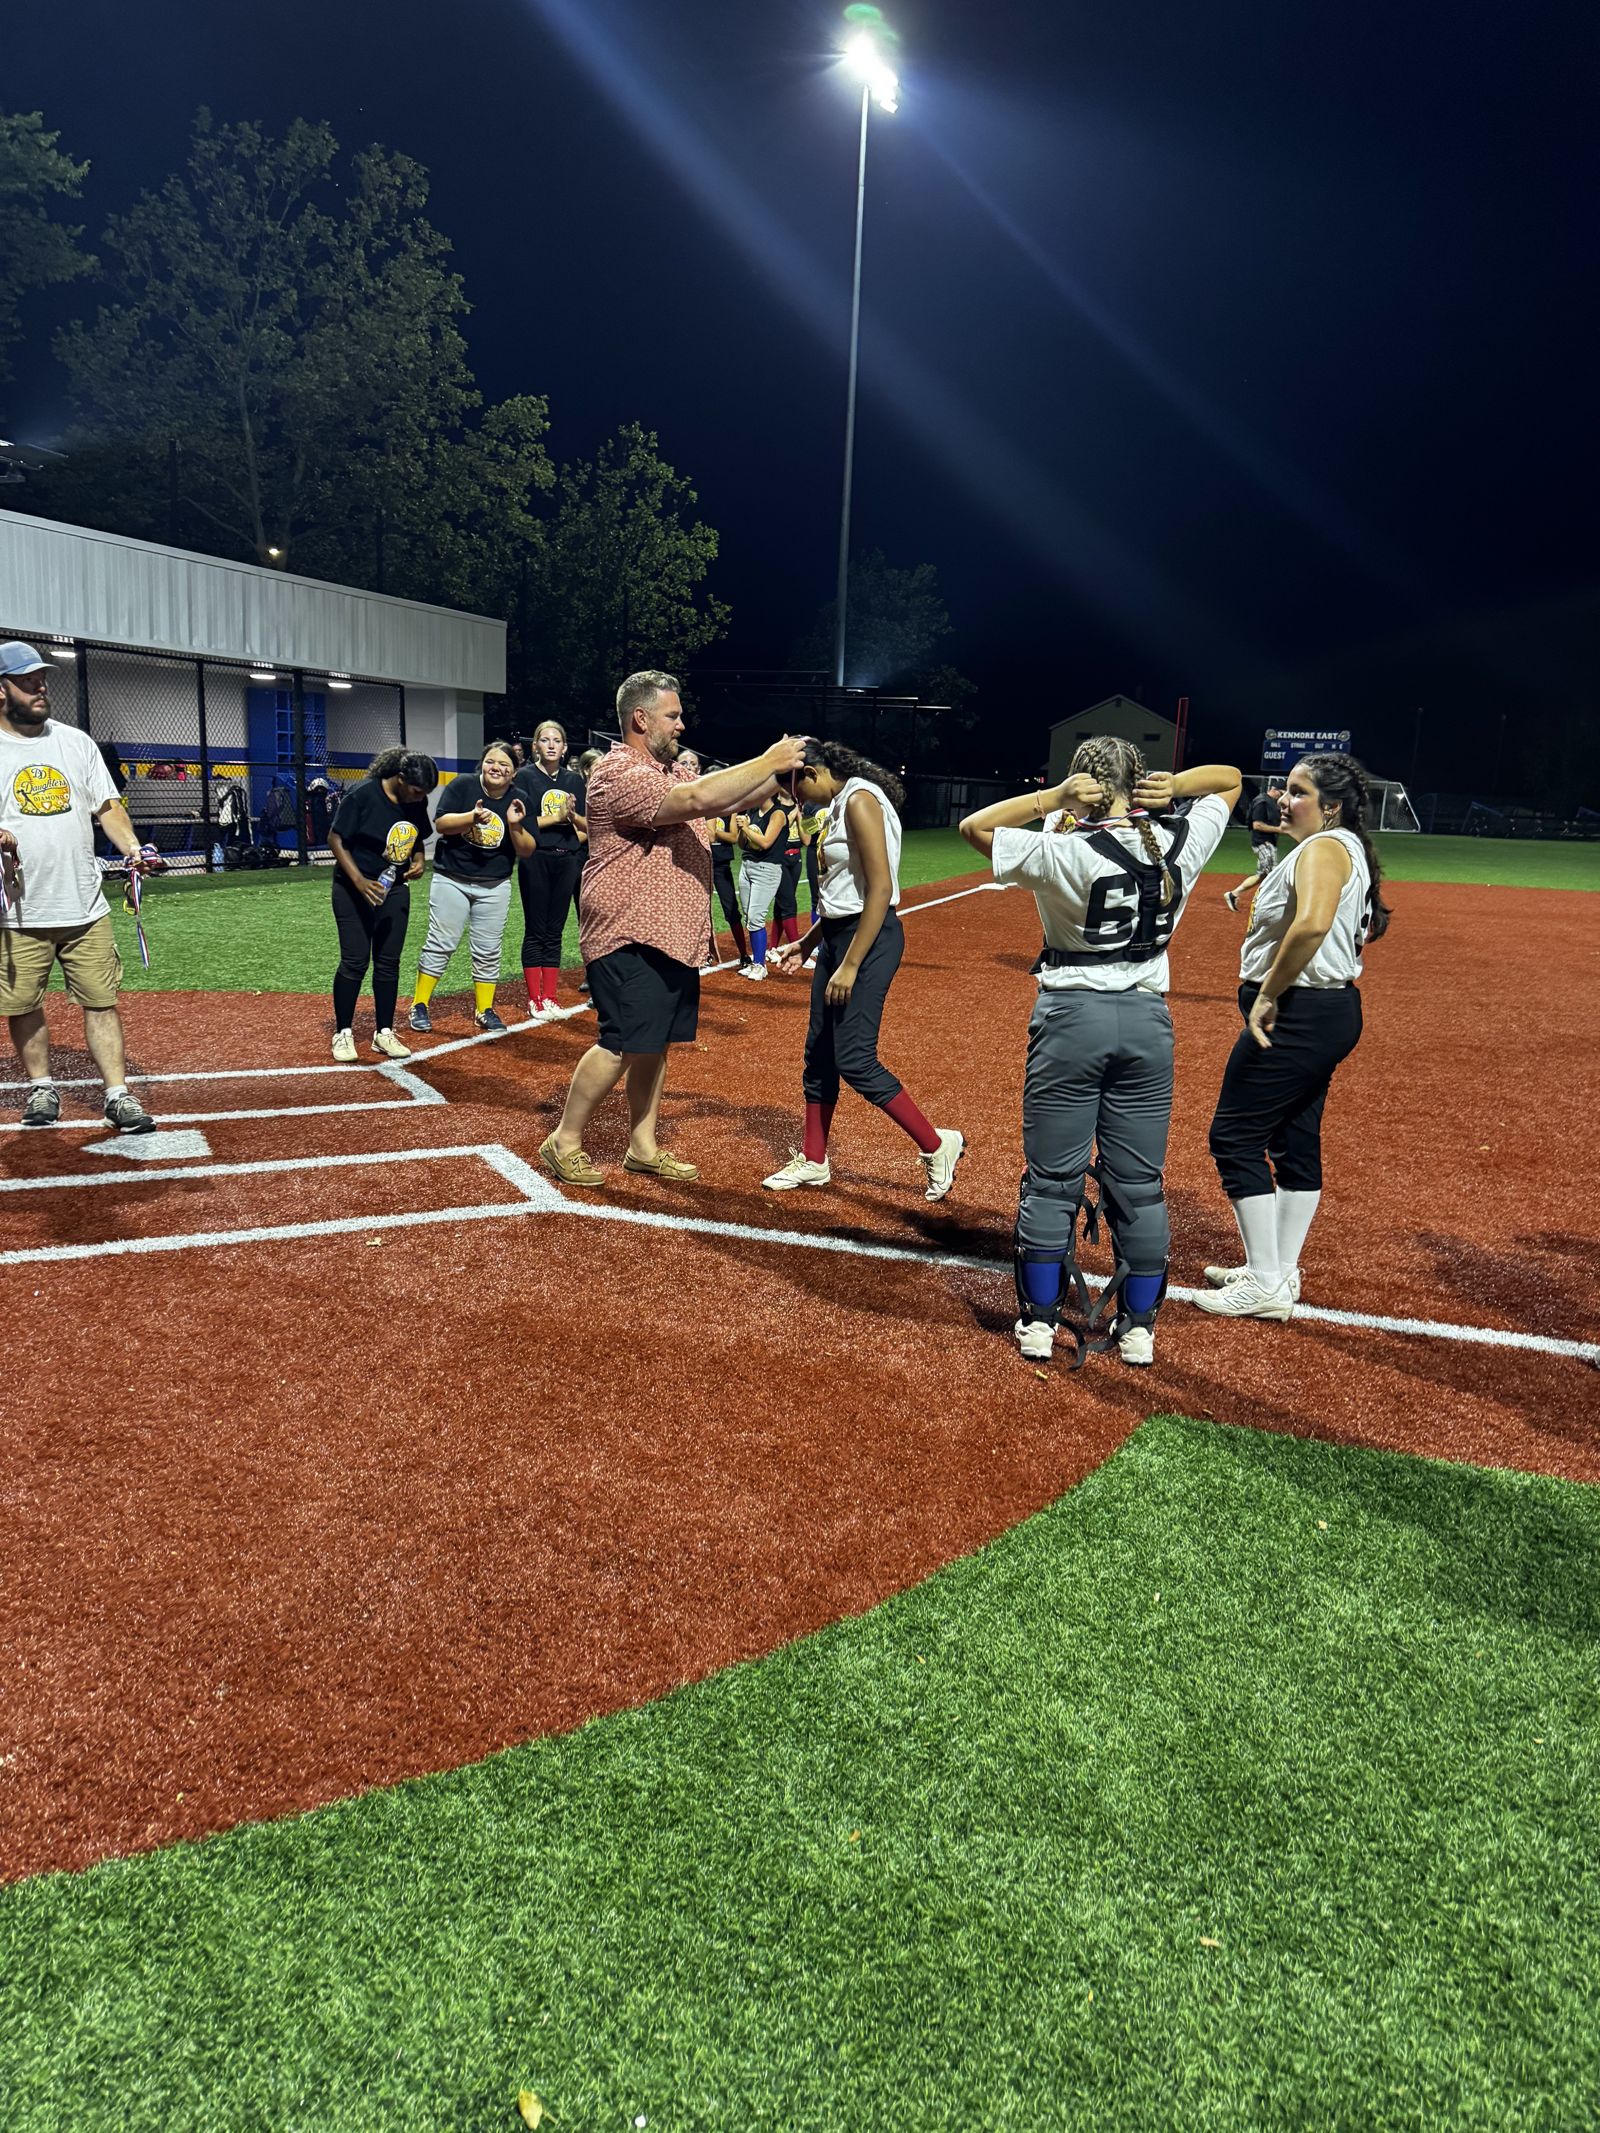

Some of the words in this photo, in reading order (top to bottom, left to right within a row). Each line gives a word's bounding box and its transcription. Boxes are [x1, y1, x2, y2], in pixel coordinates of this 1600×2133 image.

[1277, 731, 1315, 739] KENMORE
[1316, 732, 1339, 740] EAST
[1263, 751, 1286, 760] GUEST
[20, 779, 67, 794] Daughters
